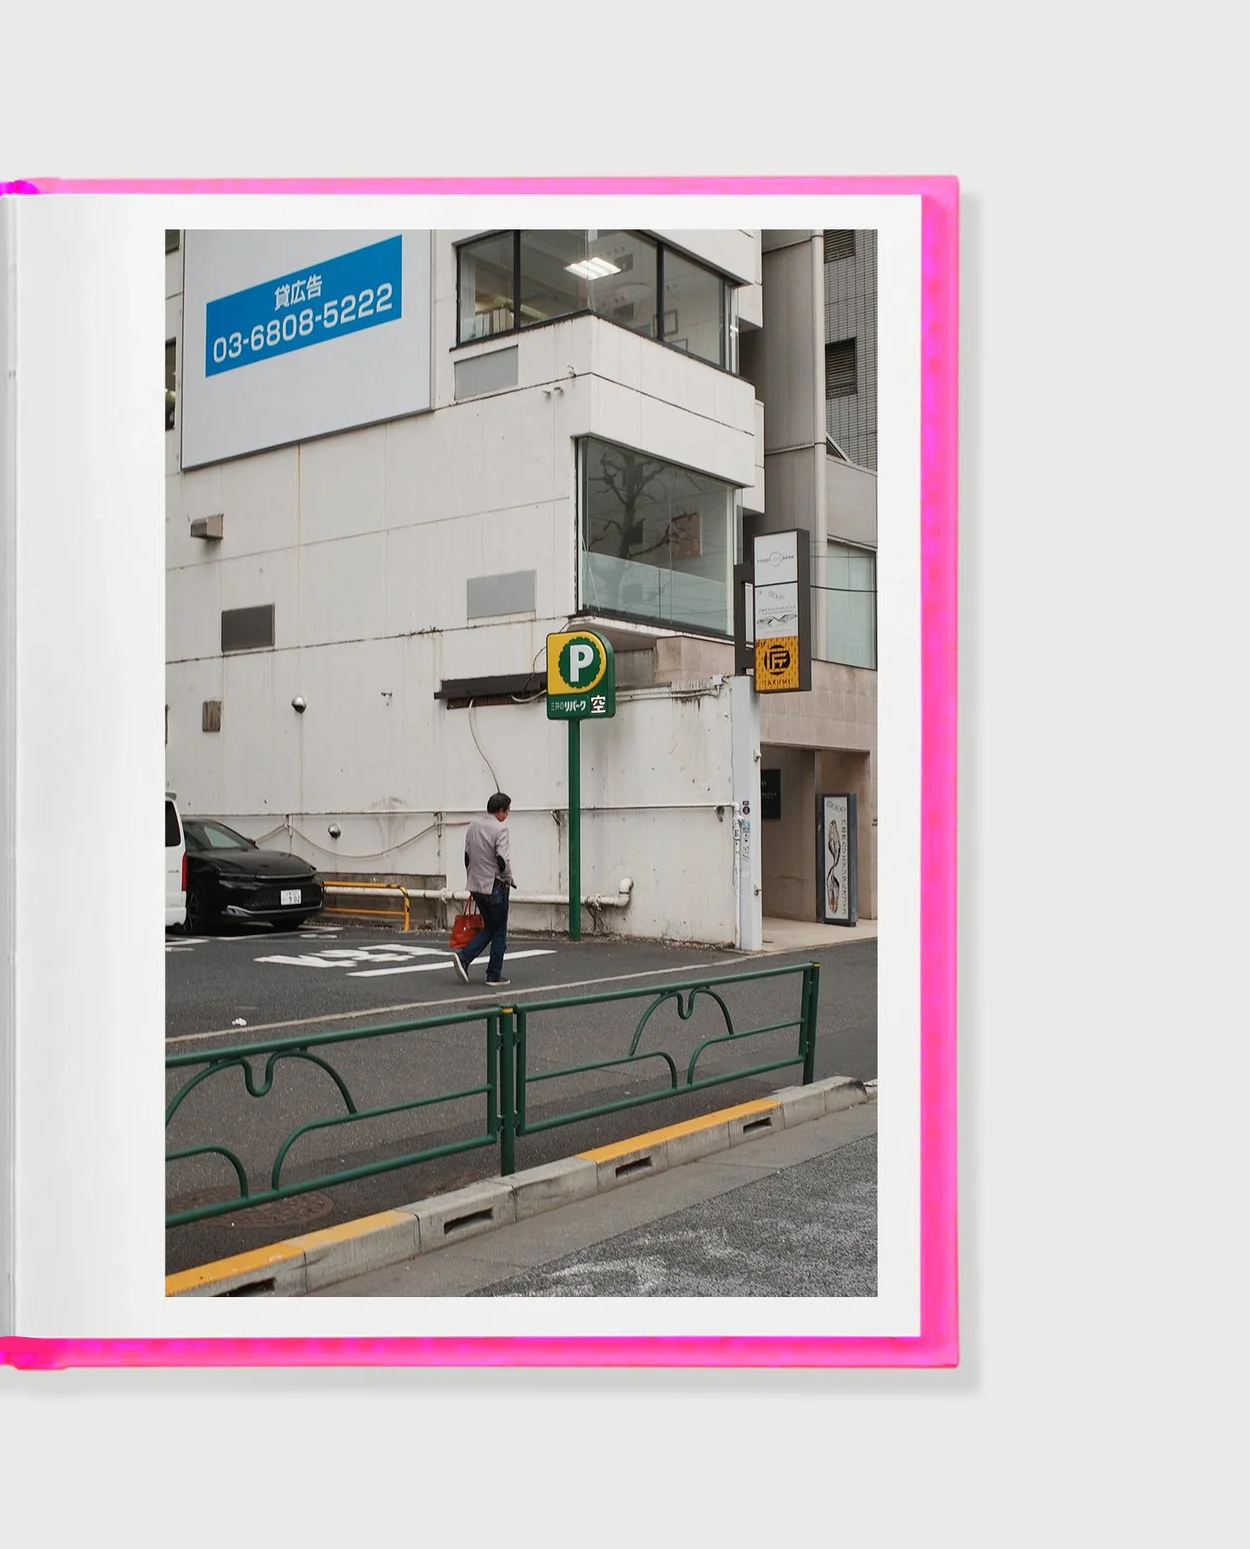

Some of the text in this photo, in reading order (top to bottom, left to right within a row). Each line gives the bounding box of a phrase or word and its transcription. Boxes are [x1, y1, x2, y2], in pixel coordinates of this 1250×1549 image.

[274, 273, 323, 312] 貸広告
[213, 282, 393, 363] 03-6808-5222
[570, 644, 594, 683] P
[590, 695, 606, 714] 空
